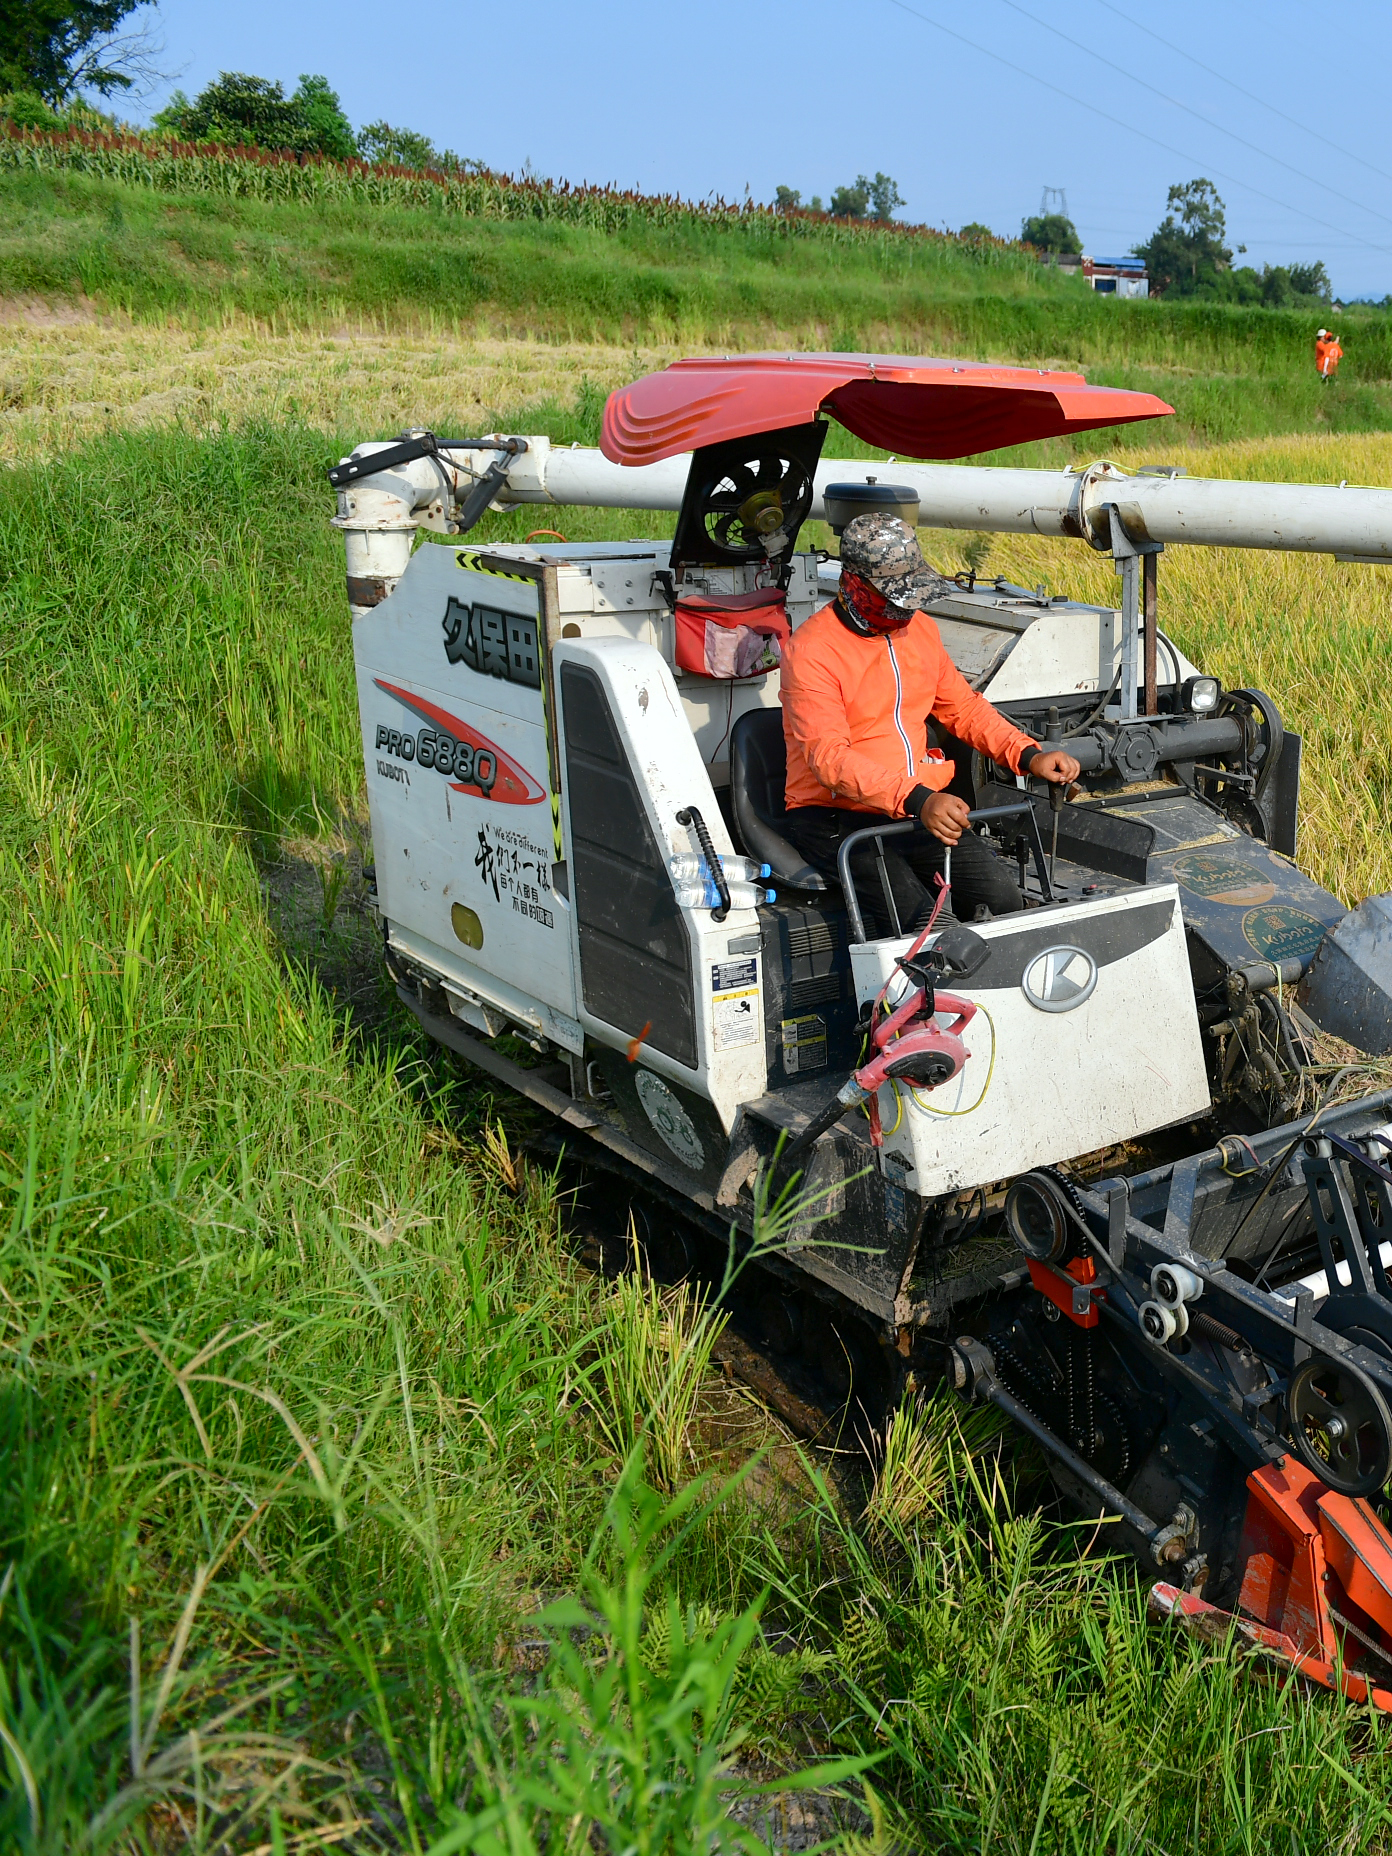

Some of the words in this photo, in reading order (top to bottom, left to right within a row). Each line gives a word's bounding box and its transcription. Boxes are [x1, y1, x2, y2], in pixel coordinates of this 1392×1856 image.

[442, 595, 542, 692] 久保田
[518, 837, 549, 860] different
[500, 872, 539, 904] 每个人都有
[1191, 869, 1246, 884] Kubota
[1261, 925, 1314, 946] Kubota
